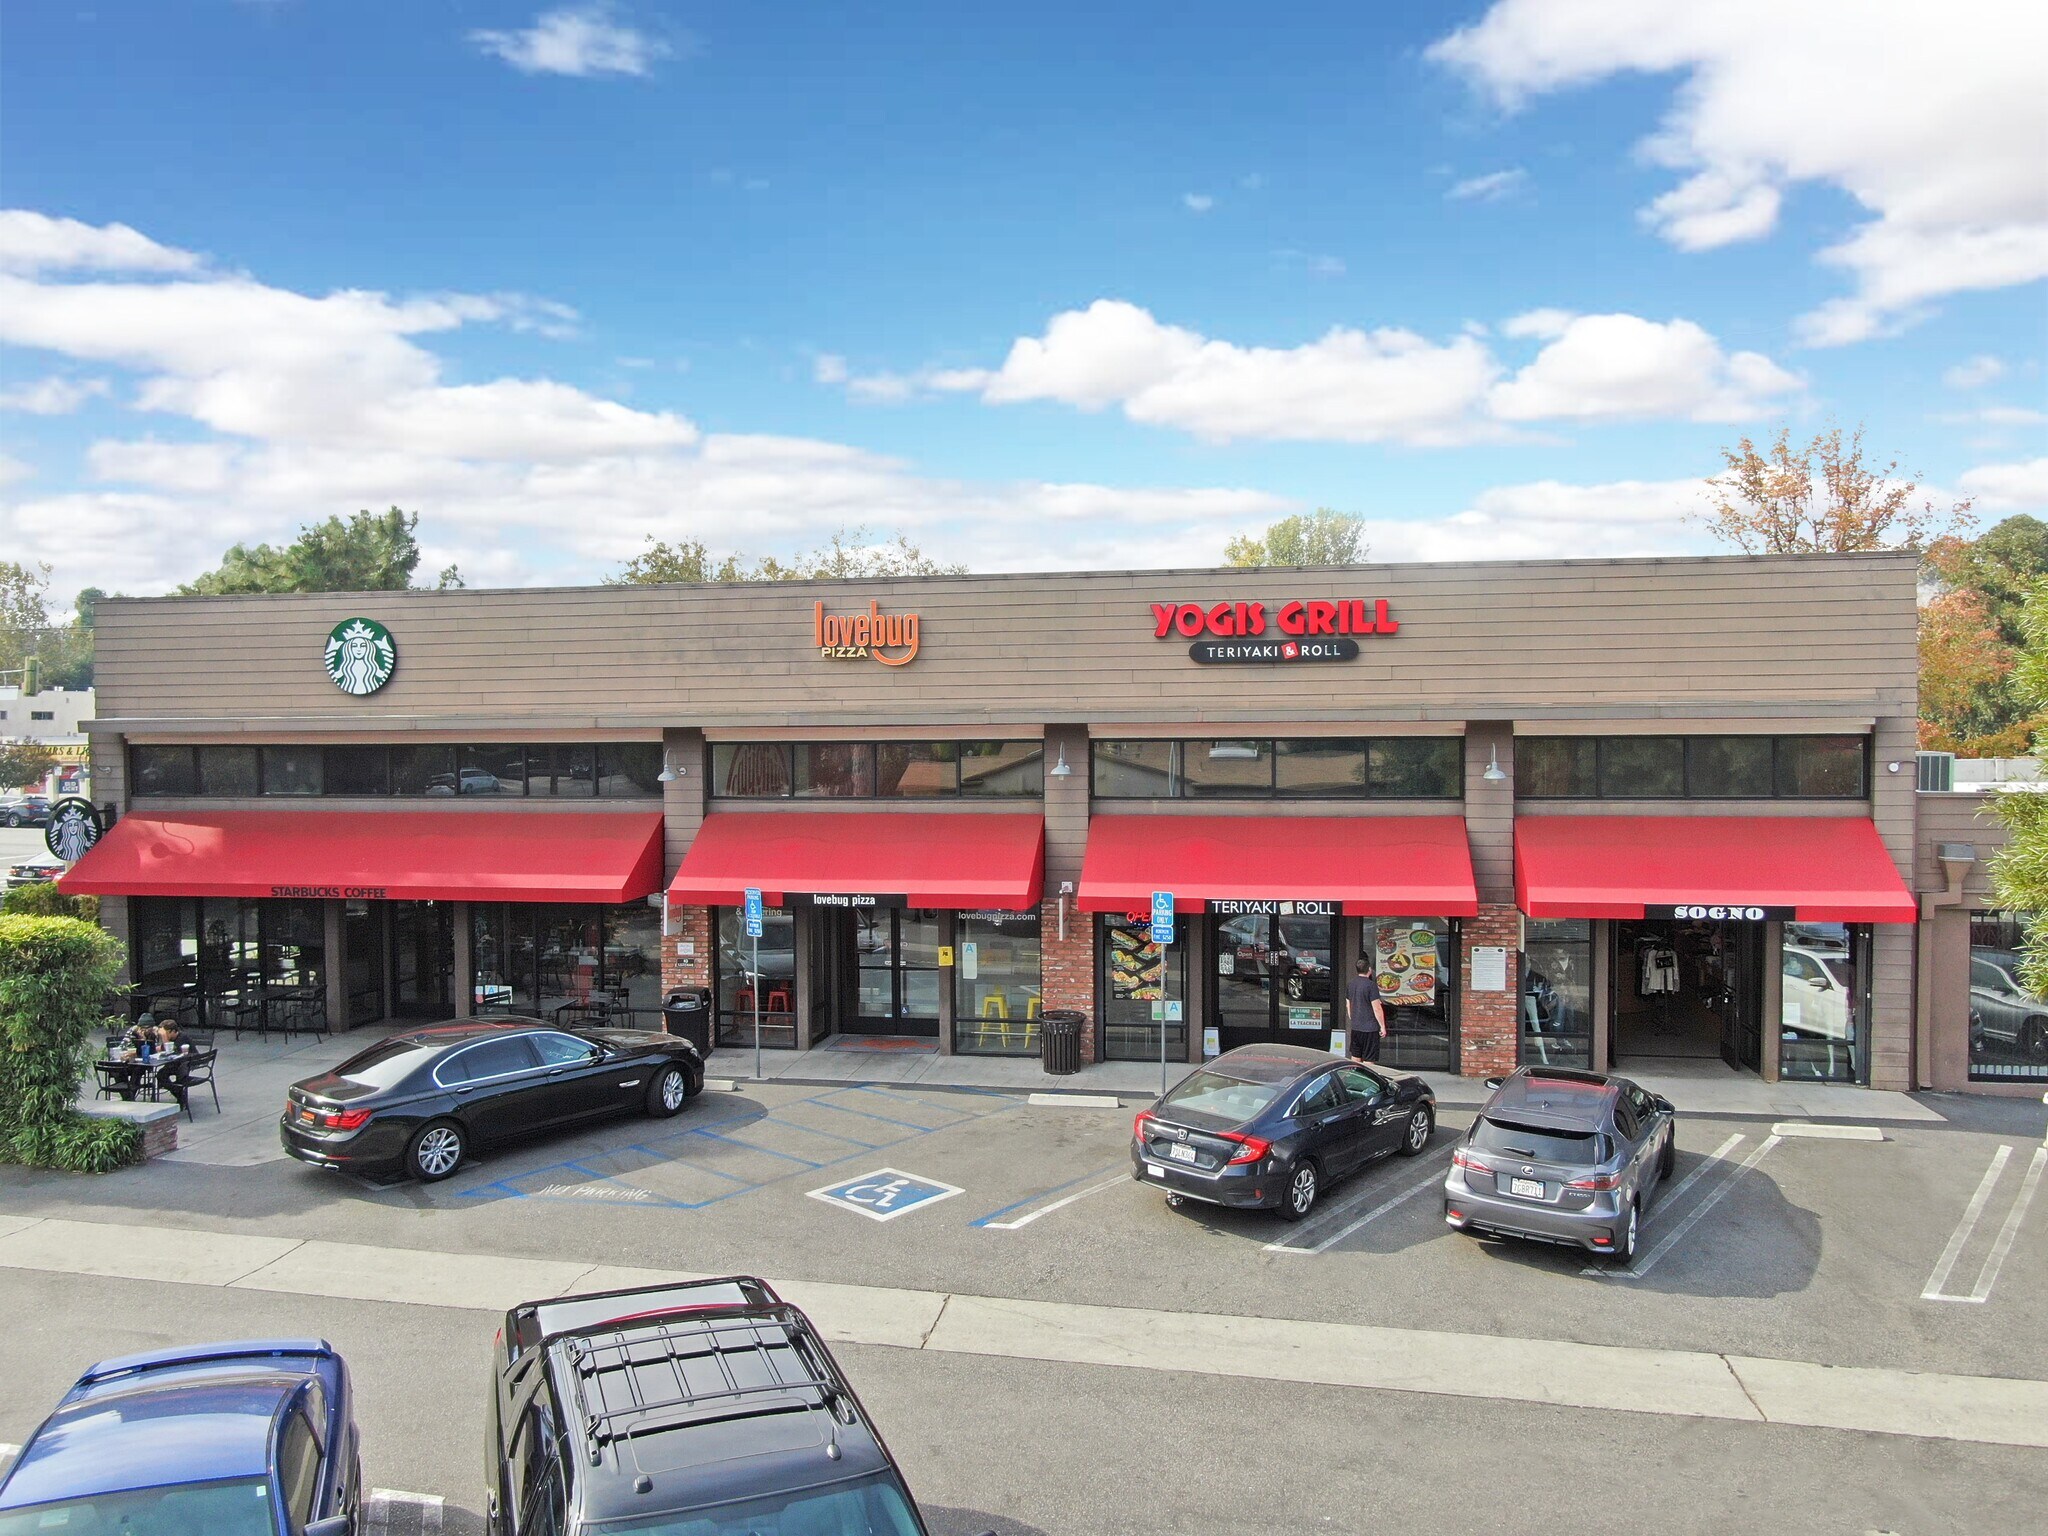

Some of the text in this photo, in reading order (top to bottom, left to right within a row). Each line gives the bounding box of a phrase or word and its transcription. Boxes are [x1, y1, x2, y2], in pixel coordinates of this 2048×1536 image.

[1150, 600, 1399, 637] YOGIS GRILL
[814, 599, 919, 665] lovebug
[821, 647, 868, 658] PIZZA
[1207, 644, 1341, 659] TERIYAKI & ROLL
[66, 747, 73, 755] &
[271, 887, 387, 898] STARBUCKS COFFEE
[813, 894, 876, 907] lovebug pizza
[1211, 901, 1277, 914] TERIYAKI
[1296, 902, 1336, 915] ROLL
[1674, 906, 1764, 920] SOGNO
[958, 912, 1036, 921] lovebugpizza.com
[1127, 911, 1152, 922] OPE
[965, 944, 974, 952] A
[1170, 1002, 1178, 1011] A
[540, 1184, 651, 1200] NO PARKING
